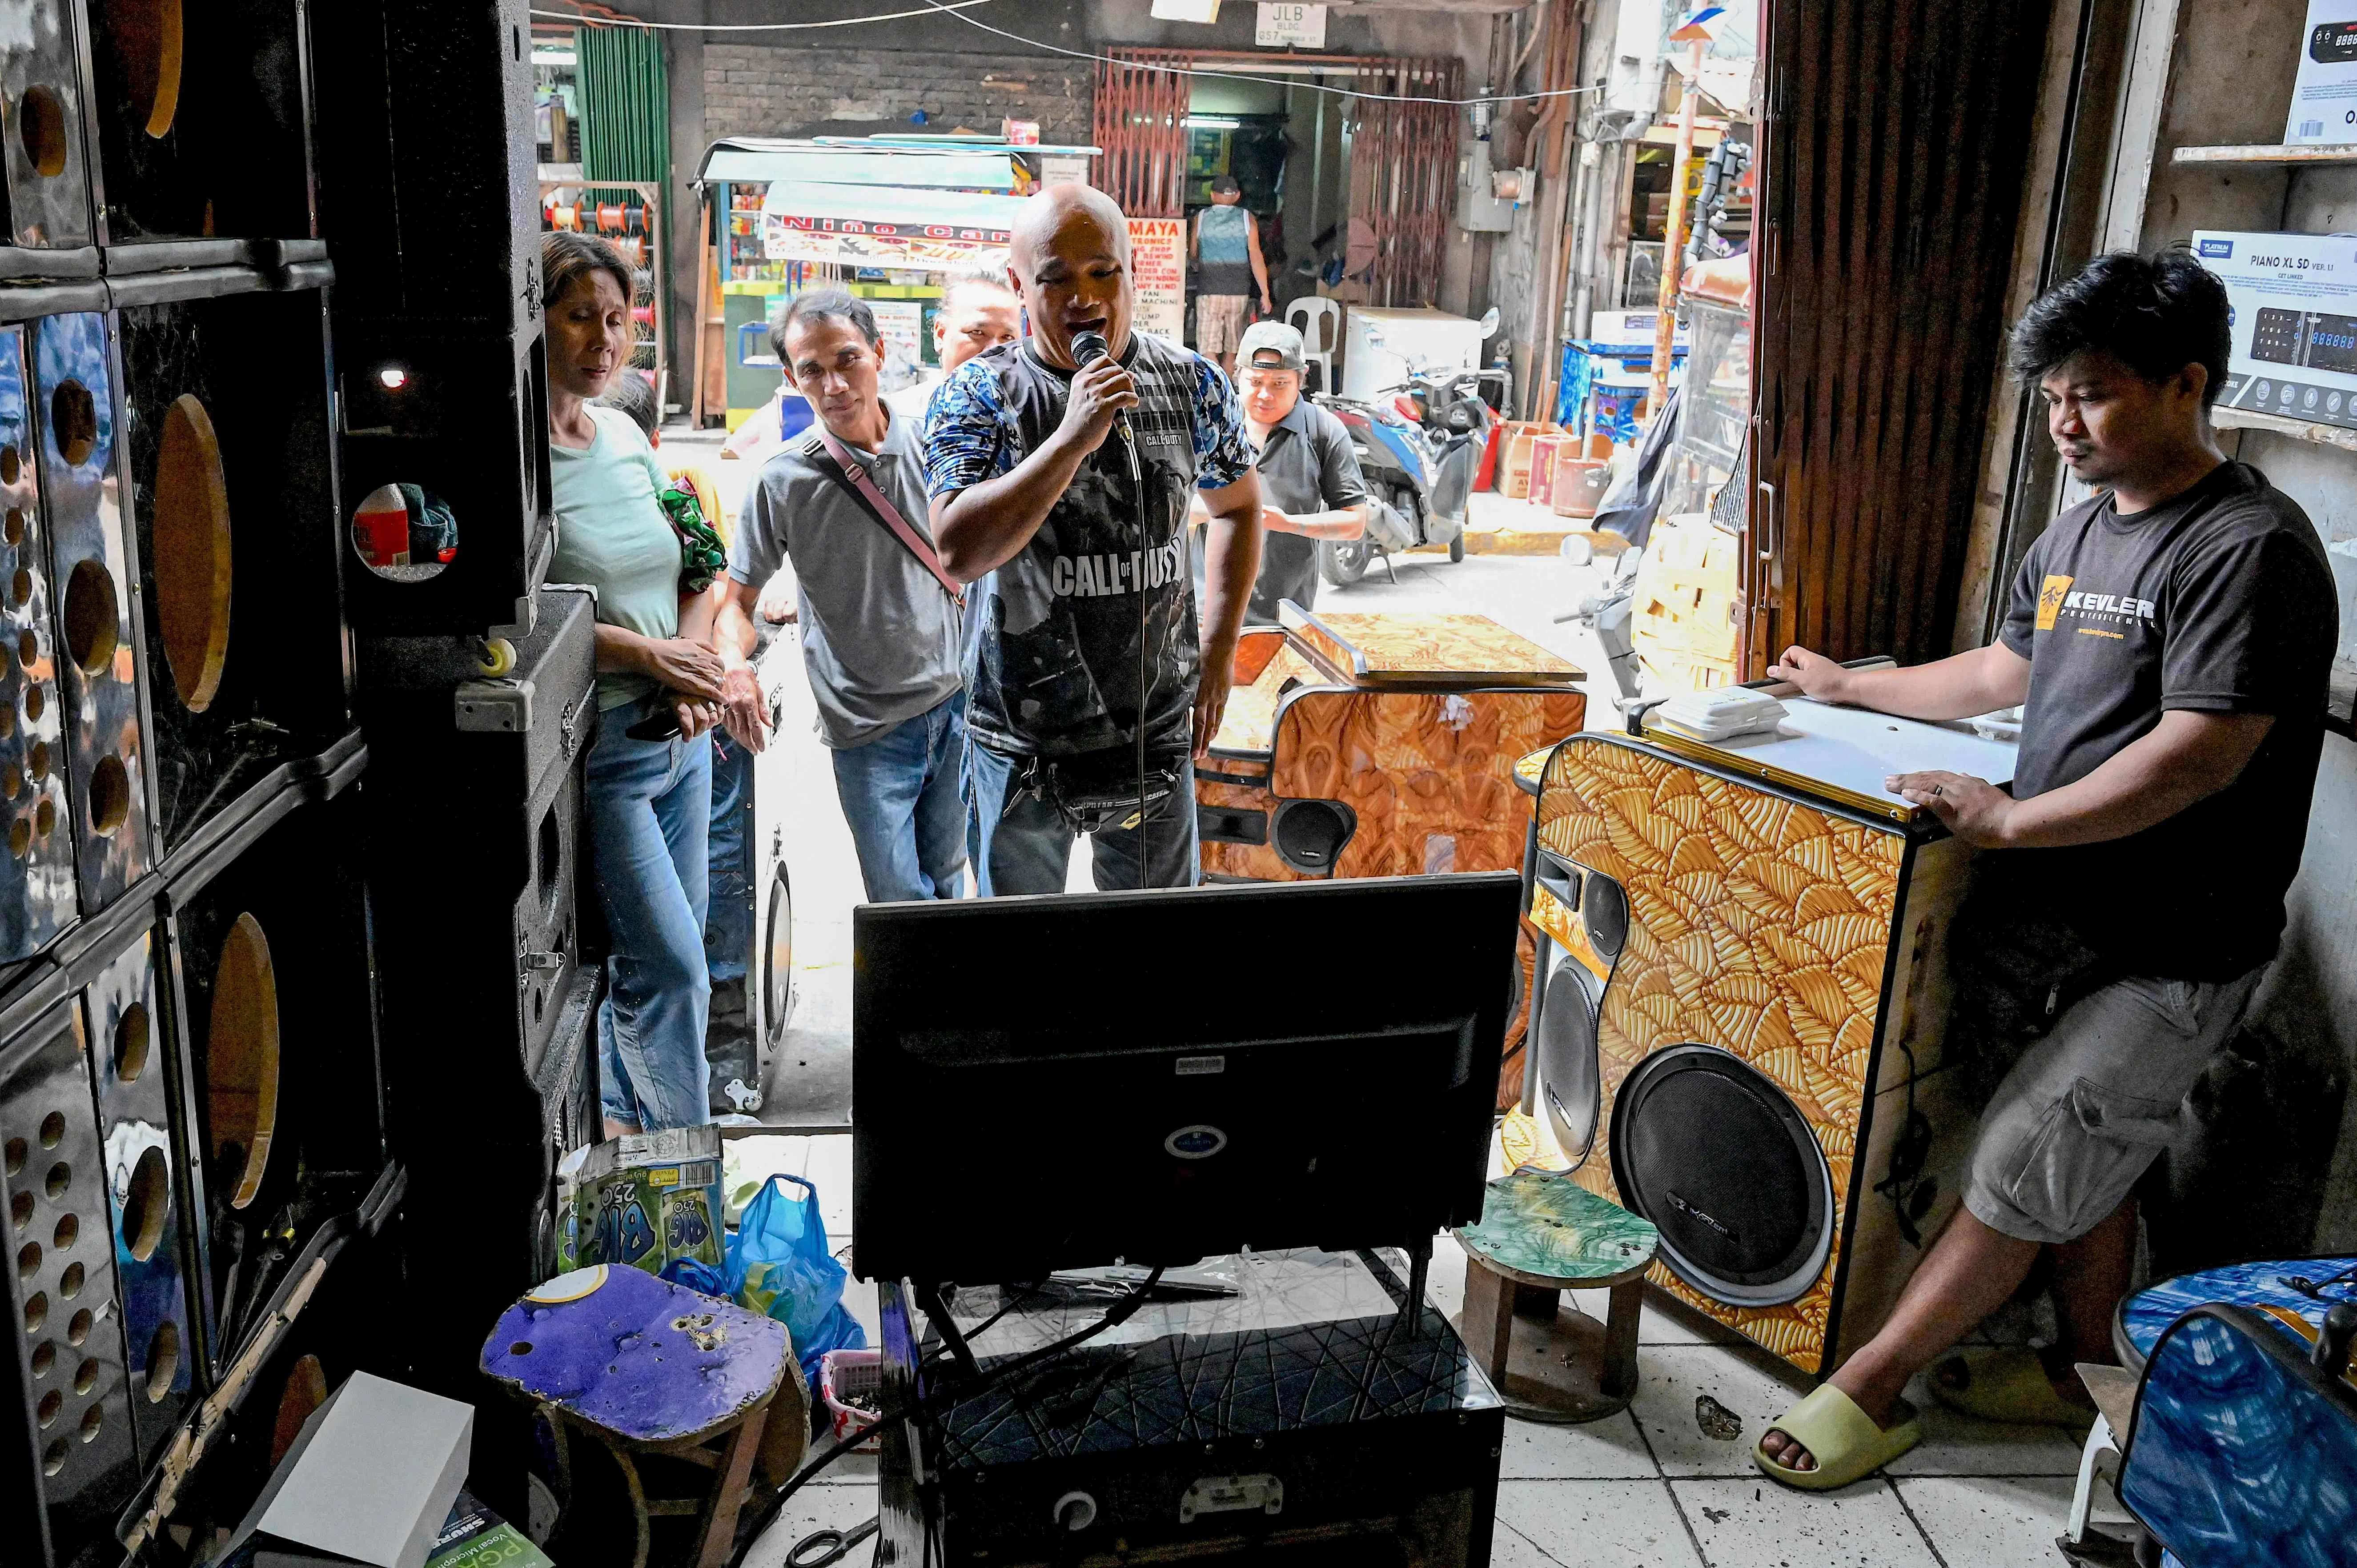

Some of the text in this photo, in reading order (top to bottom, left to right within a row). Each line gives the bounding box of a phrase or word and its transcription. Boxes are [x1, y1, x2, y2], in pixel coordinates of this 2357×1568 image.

[1273, 6, 1303, 21] JLB
[924, 225, 1010, 244] Car
[1128, 221, 1178, 237] MAYA
[2250, 255, 2280, 268] PIANO
[2282, 257, 2294, 269] XL
[2297, 257, 2310, 269] SD
[1145, 434, 1182, 446] CALL DUTY
[1052, 537, 1184, 597] CALL OF DUTY
[2064, 591, 2156, 619] KEVLER
[601, 1182, 636, 1207] 250
[673, 1200, 695, 1213] 250
[585, 1200, 656, 1265] BIG
[668, 1211, 709, 1248] BIG
[434, 1533, 509, 1568] Vocal Microph
